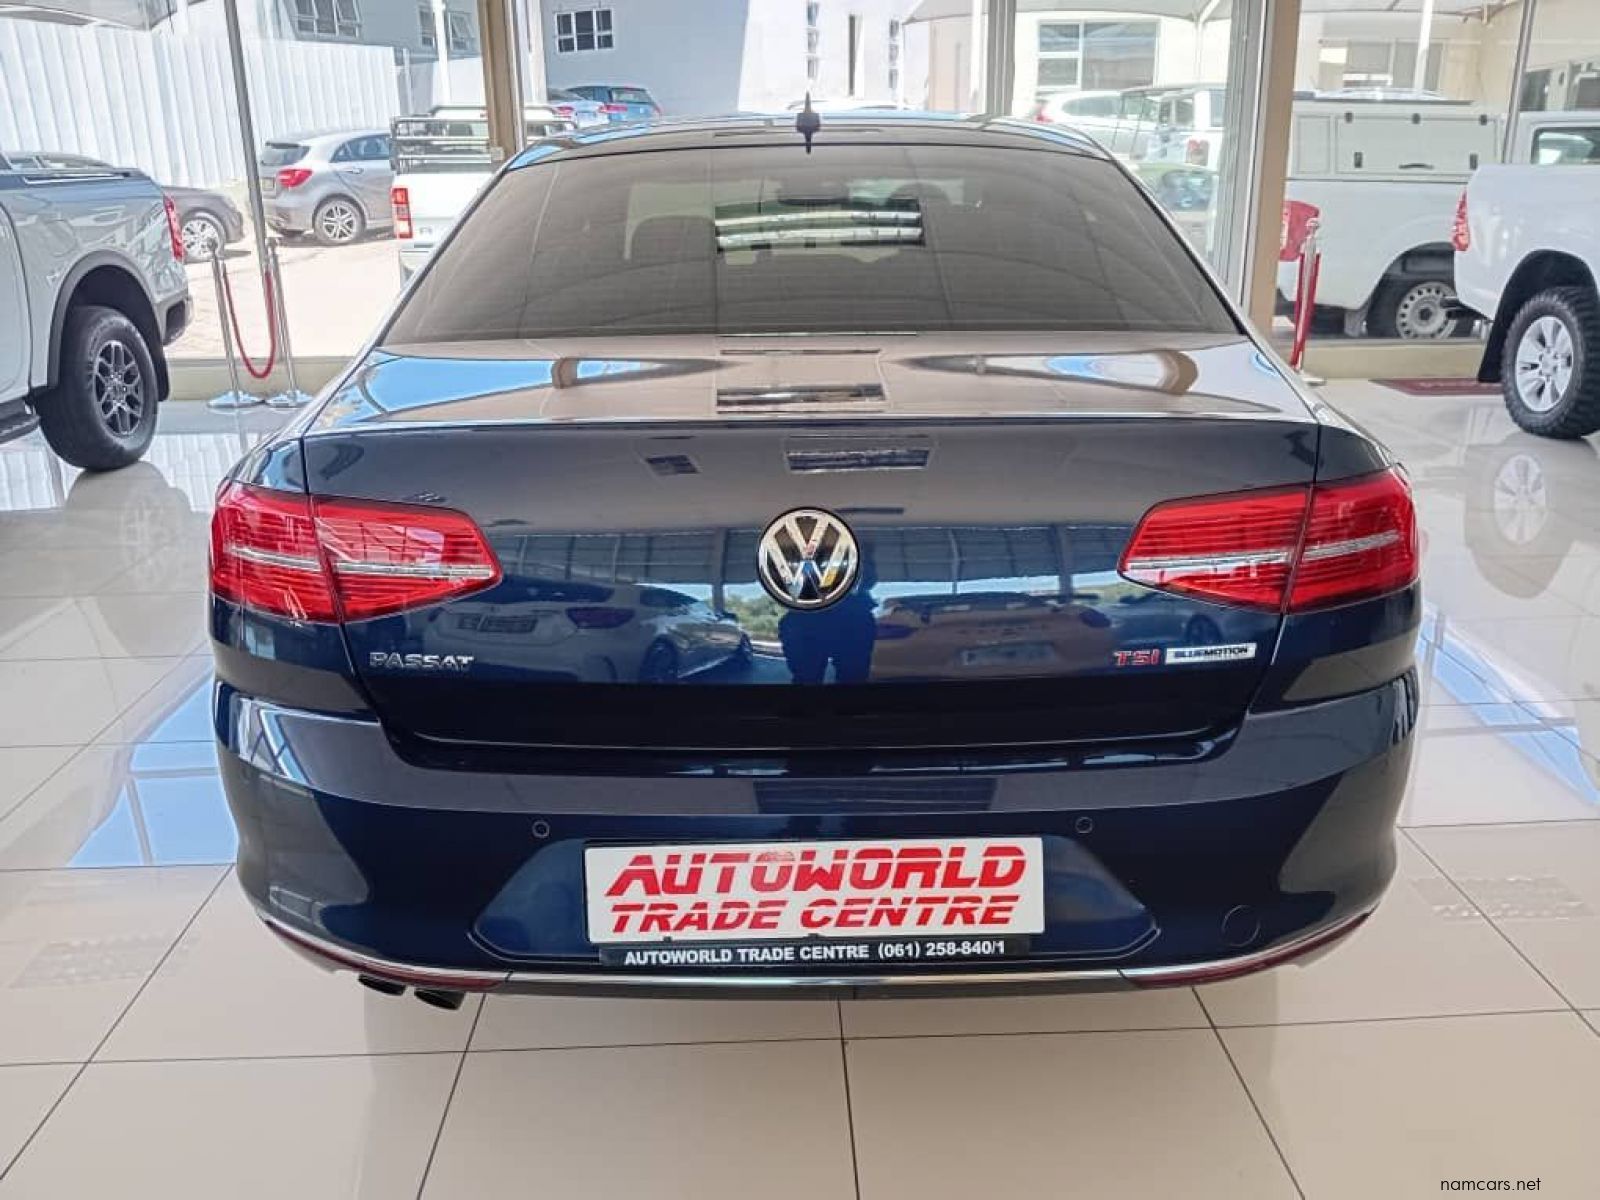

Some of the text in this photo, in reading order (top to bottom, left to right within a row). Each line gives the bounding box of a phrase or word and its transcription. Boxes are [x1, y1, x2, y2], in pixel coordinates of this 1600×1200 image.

[369, 651, 475, 671] PASSAT
[1113, 648, 1160, 667] TSI
[605, 845, 1026, 897] AUTOWORLD
[612, 895, 1021, 933] TRADE CENTRE
[624, 940, 1005, 966] AUTOWORLD TRADE CENTRE (061) 258-840/1
